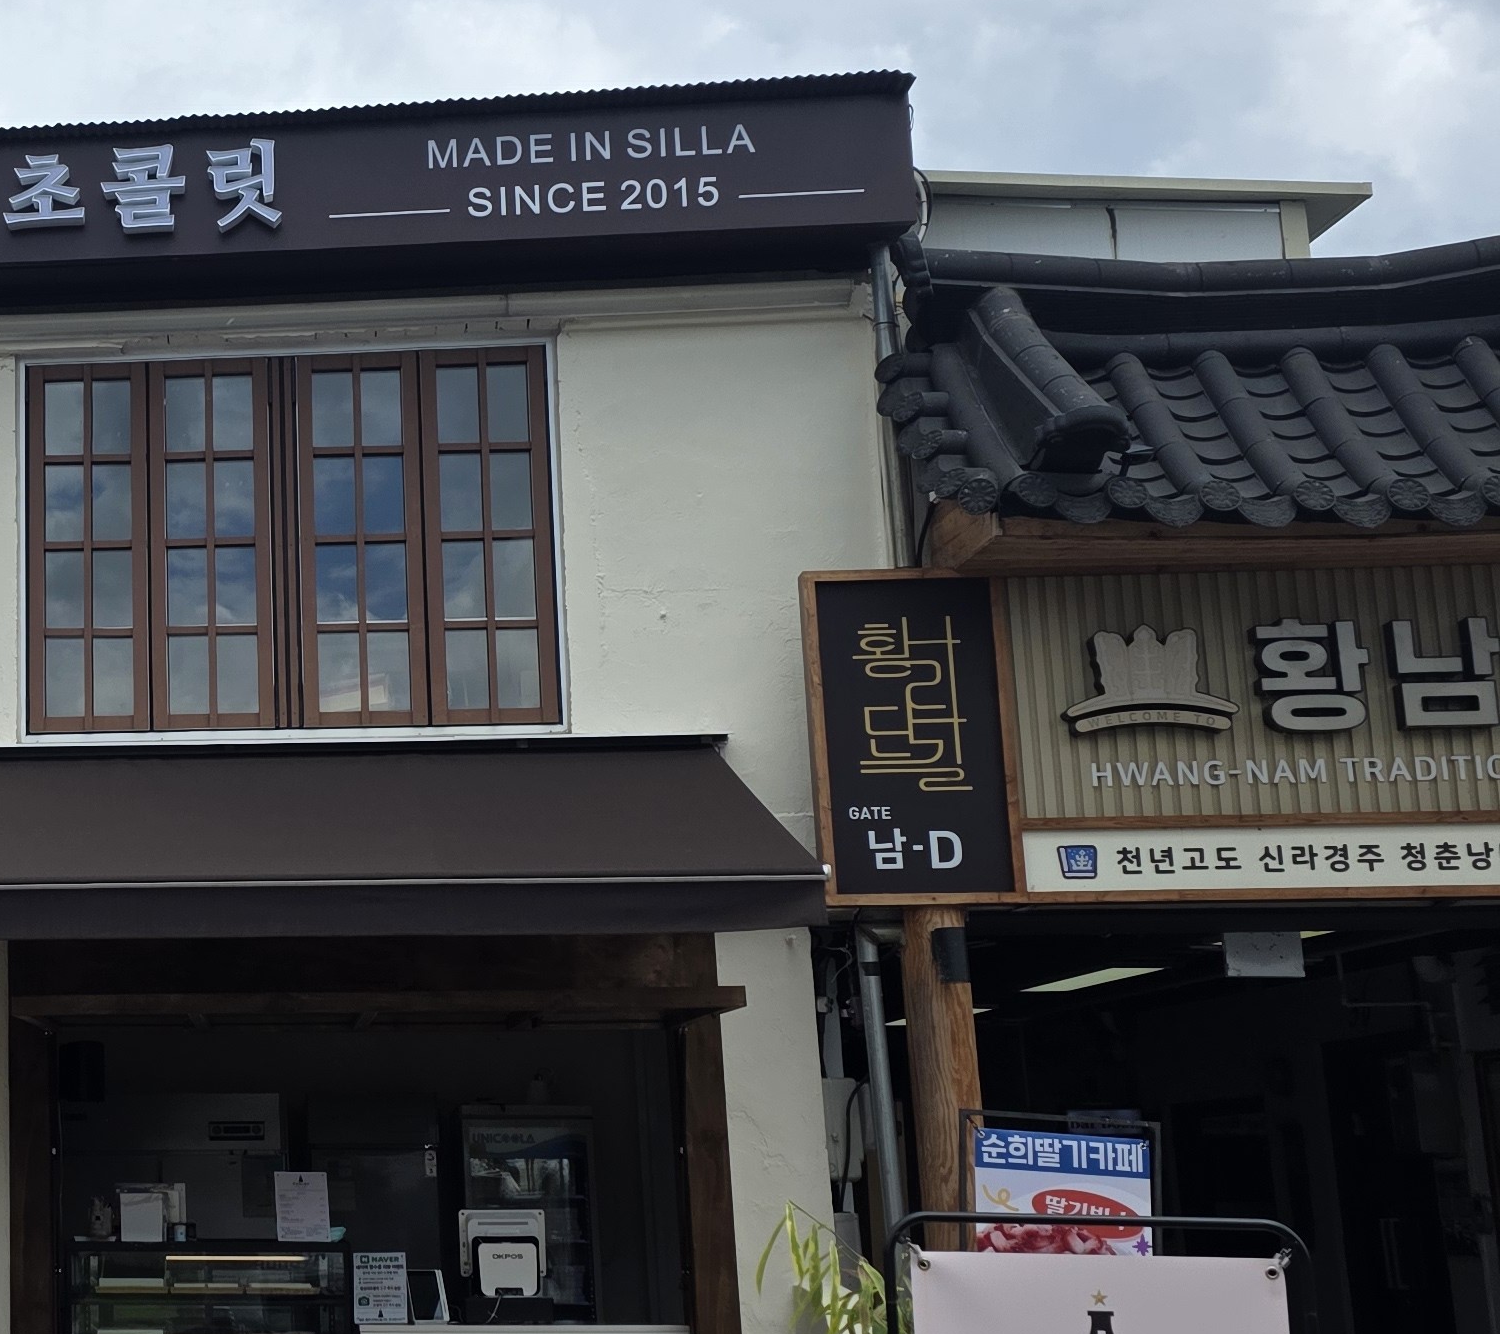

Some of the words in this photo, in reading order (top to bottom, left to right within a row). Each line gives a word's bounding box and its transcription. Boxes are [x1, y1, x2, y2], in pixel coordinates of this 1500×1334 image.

[426, 132, 554, 169] MADE
[568, 130, 612, 163] IN
[626, 124, 756, 160] SILLA
[3, 138, 283, 235] 초콜릿
[467, 180, 608, 217] SINCE
[620, 176, 720, 210] 2015
[1250, 617, 1500, 734] 황남
[1087, 710, 1181, 729] WELCOME
[1194, 713, 1216, 727] TO
[1091, 758, 1328, 787] HWANG-NAM
[849, 806, 891, 819] GATE
[867, 827, 963, 870] 남-D
[1116, 846, 1242, 875] 천년고도
[1258, 844, 1385, 873] 신라경주
[1400, 842, 1500, 871] 청춘낭
[981, 1133, 1144, 1173] 순희딸기카페
